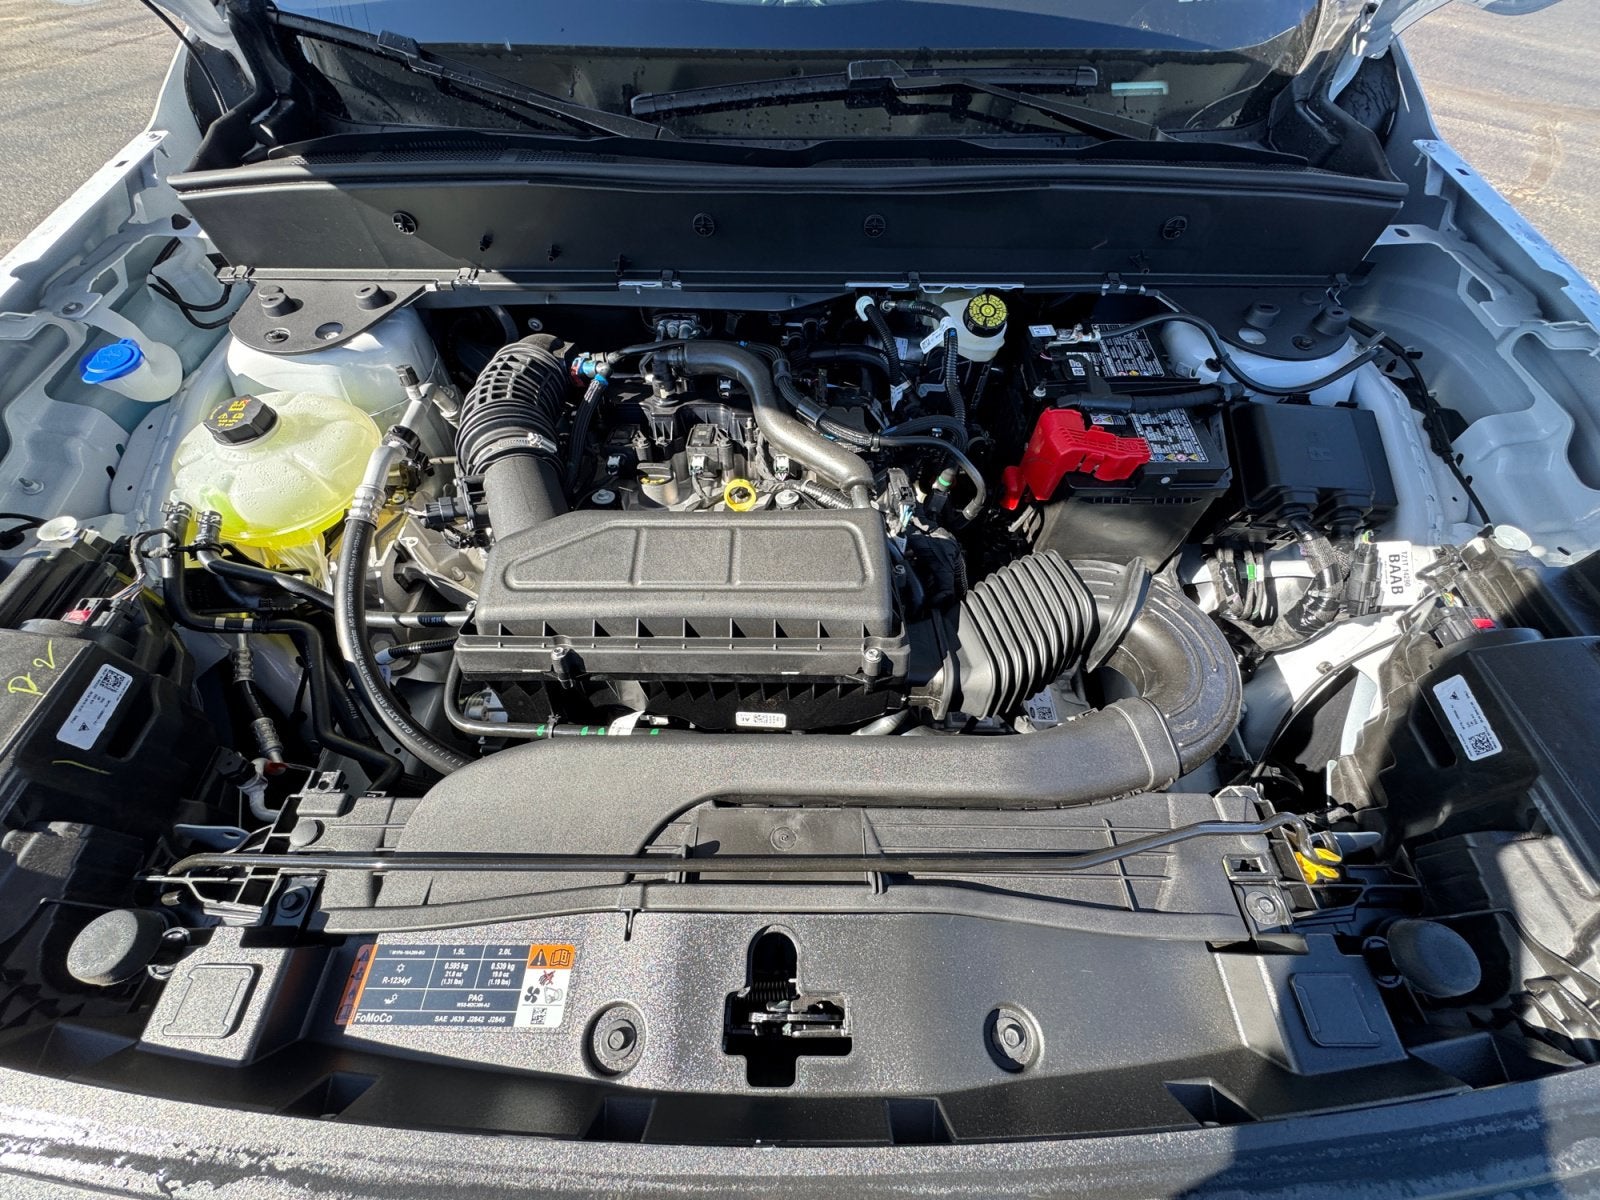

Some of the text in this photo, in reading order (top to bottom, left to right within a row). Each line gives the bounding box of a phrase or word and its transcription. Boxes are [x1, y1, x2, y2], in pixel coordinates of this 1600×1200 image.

[1388, 554, 1404, 595] BAAB
[384, 707, 412, 734] GALAXY
[498, 948, 512, 956] 2.0L
[460, 962, 469, 971] kg
[507, 962, 515, 971] kg
[381, 976, 412, 986] R-1234yf
[467, 994, 484, 1002] PAG
[354, 1012, 393, 1023] FoMoCo
